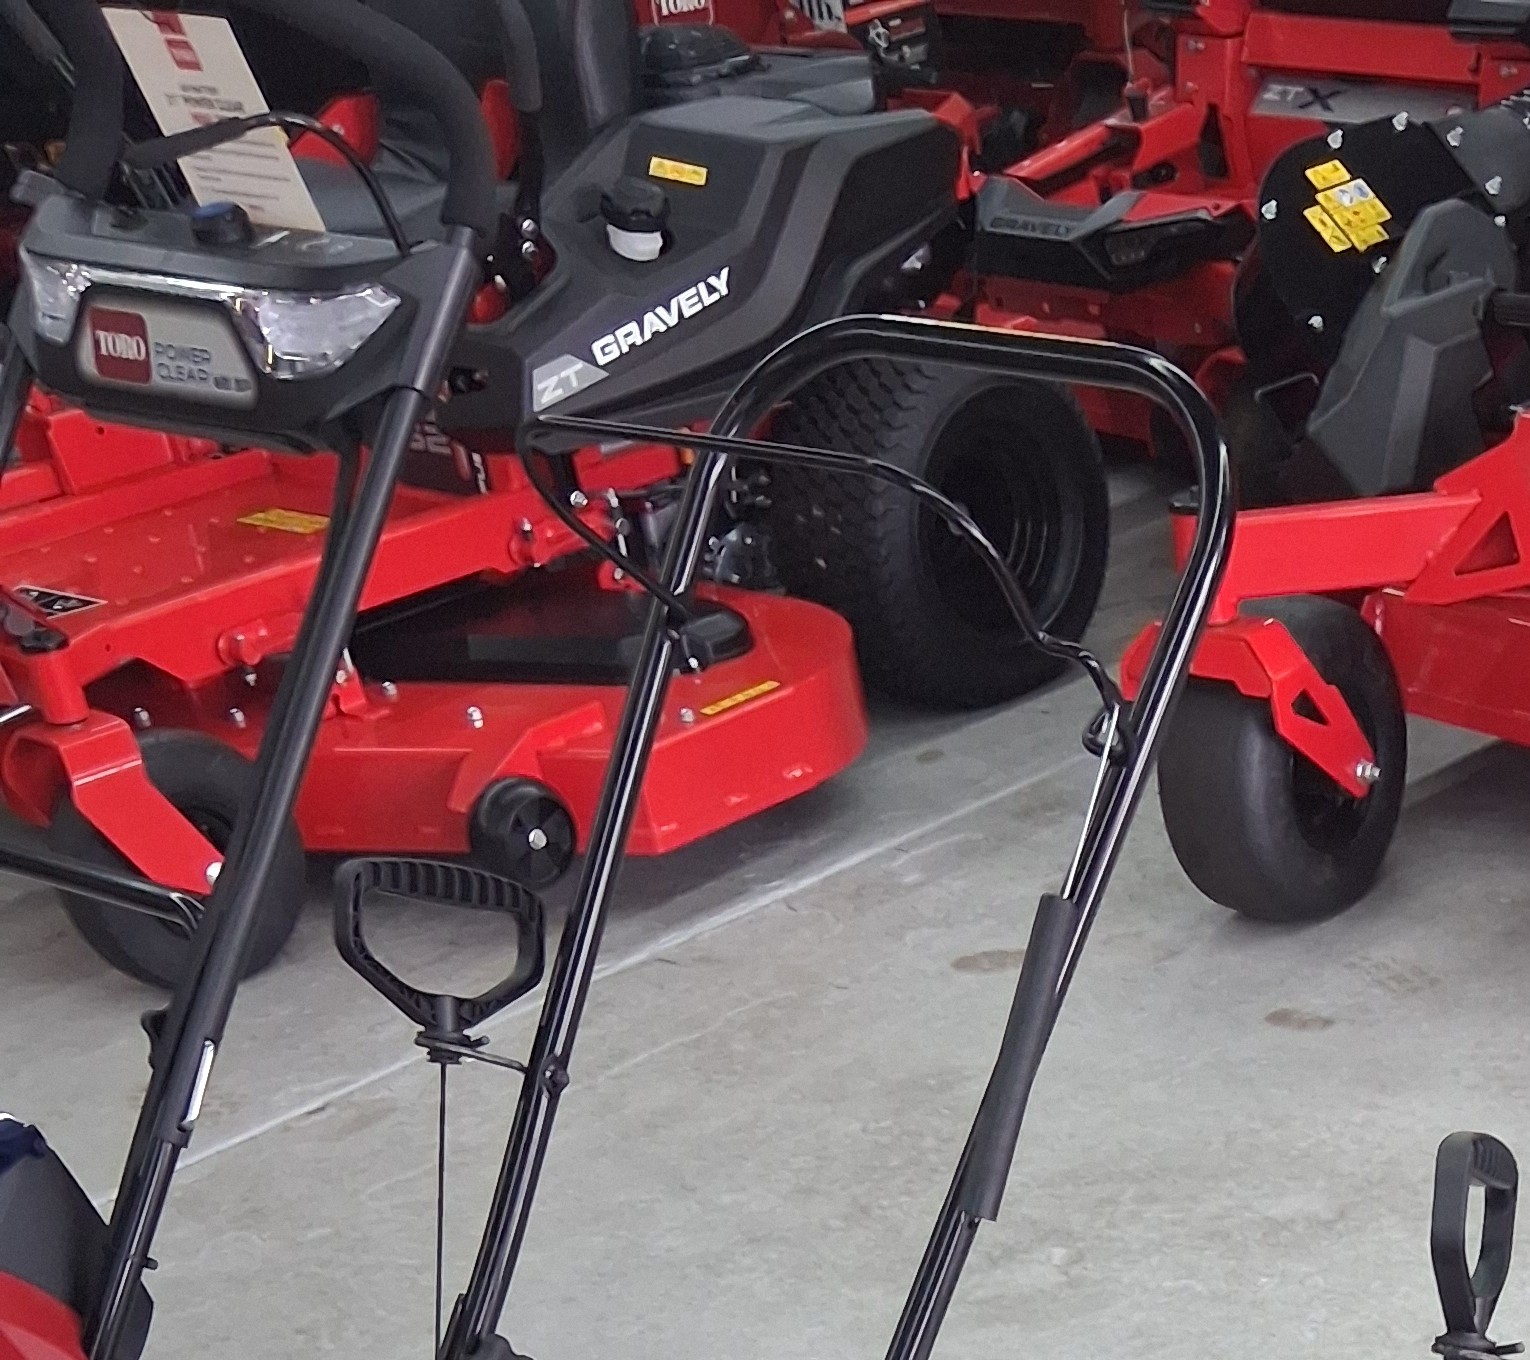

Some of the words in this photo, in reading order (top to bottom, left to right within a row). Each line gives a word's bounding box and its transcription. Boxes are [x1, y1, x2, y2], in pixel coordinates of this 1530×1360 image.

[591, 266, 730, 366] GRAVELY
[95, 330, 147, 361] TORO
[537, 362, 583, 404] ZT
